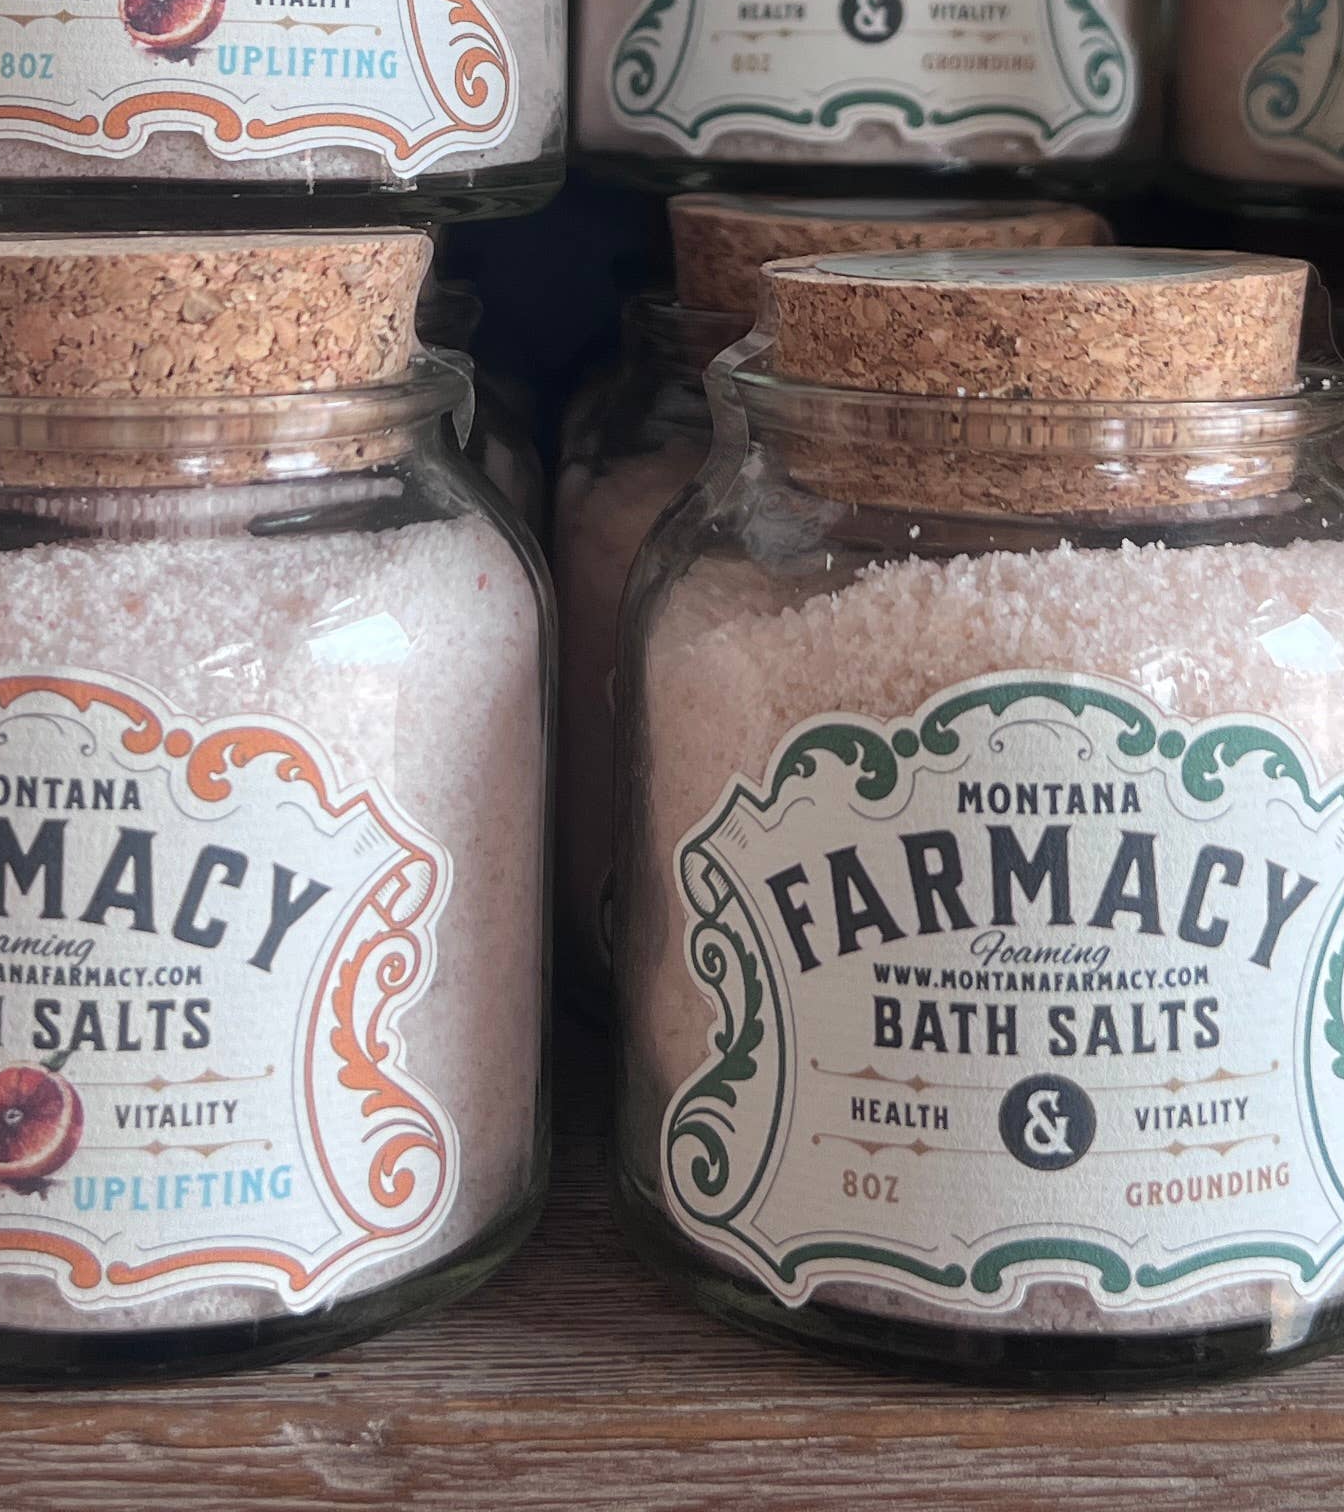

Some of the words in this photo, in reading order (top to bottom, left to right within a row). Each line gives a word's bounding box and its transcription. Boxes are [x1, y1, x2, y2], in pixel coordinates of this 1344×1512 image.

[930, 3, 1009, 20] VITALITY
[217, 45, 398, 78] UPLIFTING
[957, 782, 1141, 815] MONTANA
[764, 825, 1319, 973] FARMACY
[970, 930, 1111, 975] Foaming
[873, 962, 1209, 993] WWW.MONTANAFARMACY.COM
[32, 998, 211, 1051] SALTS
[873, 995, 1018, 1055] BATH
[1048, 996, 1220, 1056] SALTS
[114, 1099, 238, 1130] VITALITY
[851, 1096, 950, 1131] HEALTH
[1134, 1096, 1250, 1132] VITALITY
[73, 1164, 293, 1211] UPLIFTING
[1125, 1163, 1291, 1208] GROUNDING
